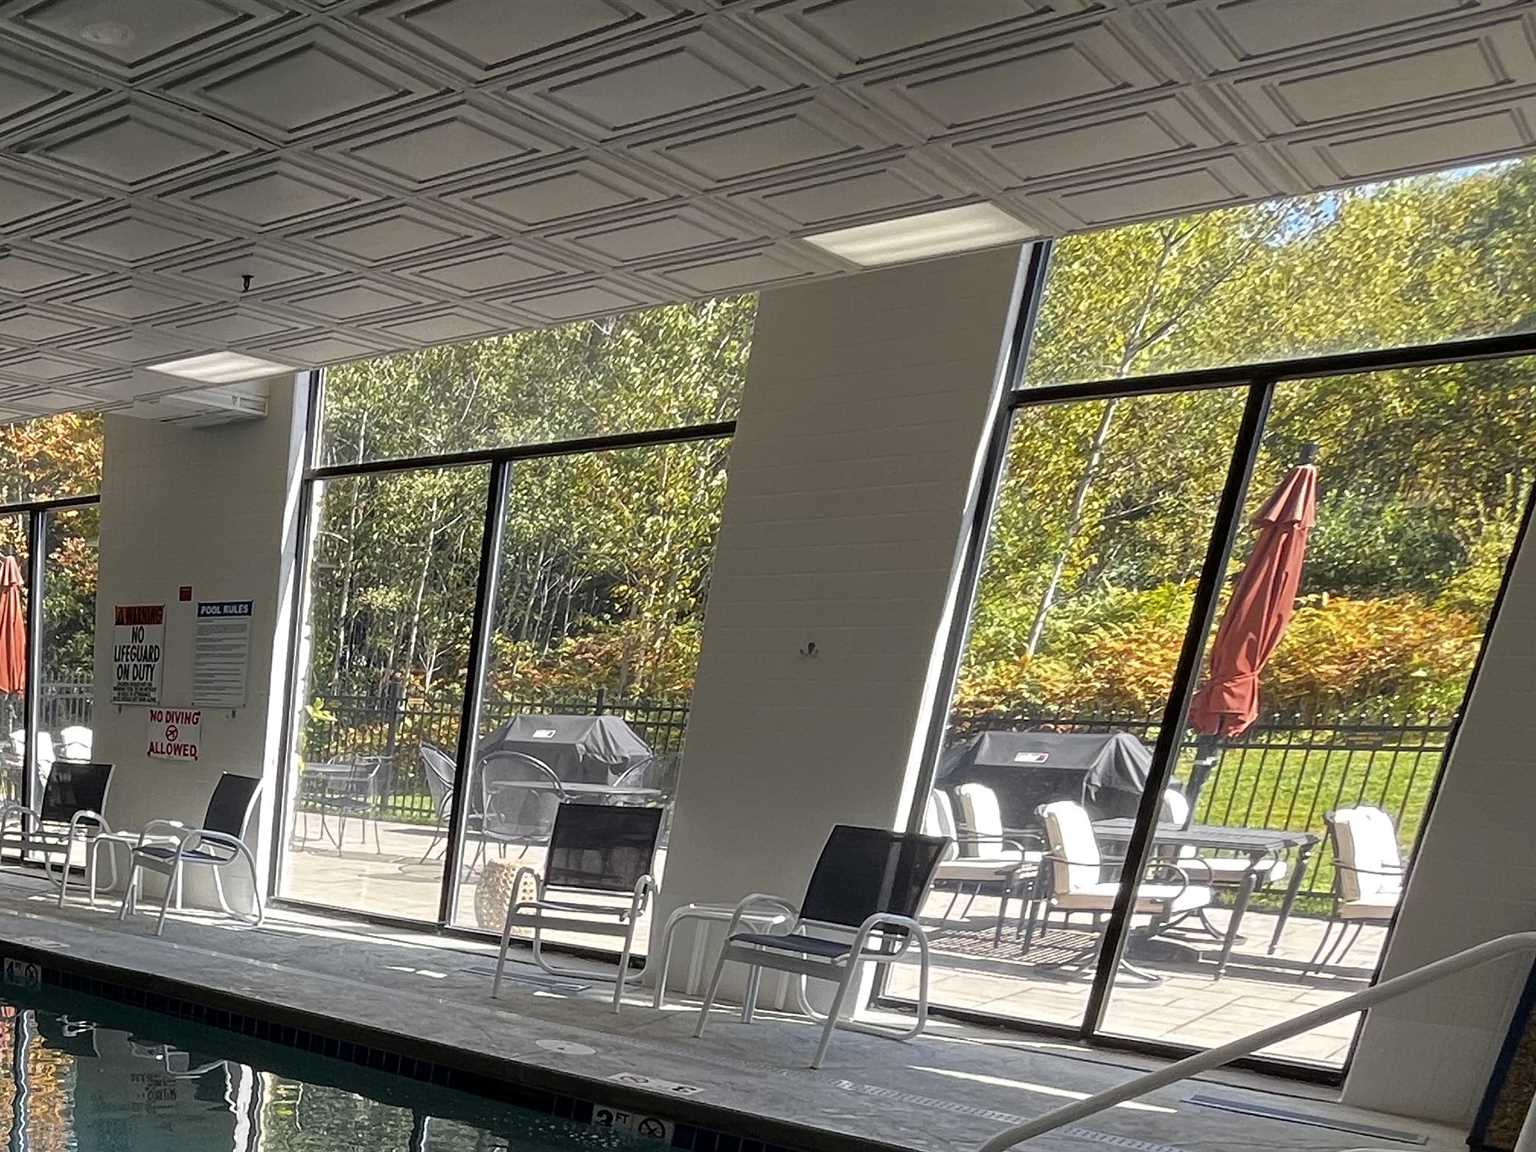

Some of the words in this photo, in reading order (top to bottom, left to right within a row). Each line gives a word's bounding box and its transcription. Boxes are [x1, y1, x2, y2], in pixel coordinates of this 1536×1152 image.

[200, 604, 222, 615] POOL
[223, 603, 249, 614] RULES
[131, 626, 145, 644] NO
[114, 645, 160, 663] LIFEGUARD
[116, 664, 130, 681] ON
[132, 664, 154, 681] DUTY
[150, 710, 164, 724] NO
[165, 711, 200, 725] DIVING
[148, 742, 197, 757] ALLOWED
[616, 1112, 630, 1124] FT
